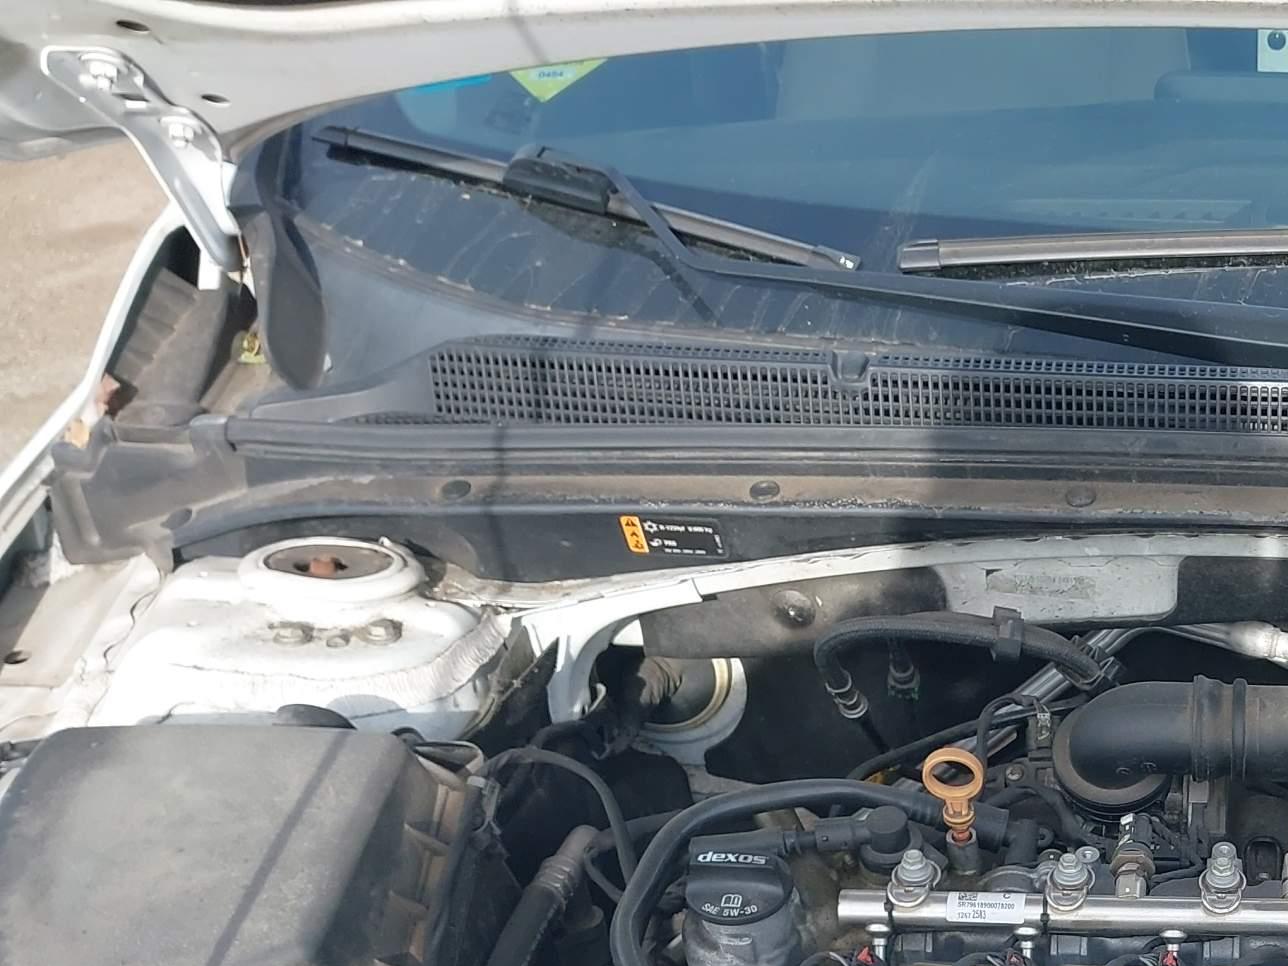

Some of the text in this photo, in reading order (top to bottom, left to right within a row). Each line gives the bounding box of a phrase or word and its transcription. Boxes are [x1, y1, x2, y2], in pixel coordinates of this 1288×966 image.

[697, 851, 768, 865] dexos
[701, 903, 758, 917] SAE 5W-30
